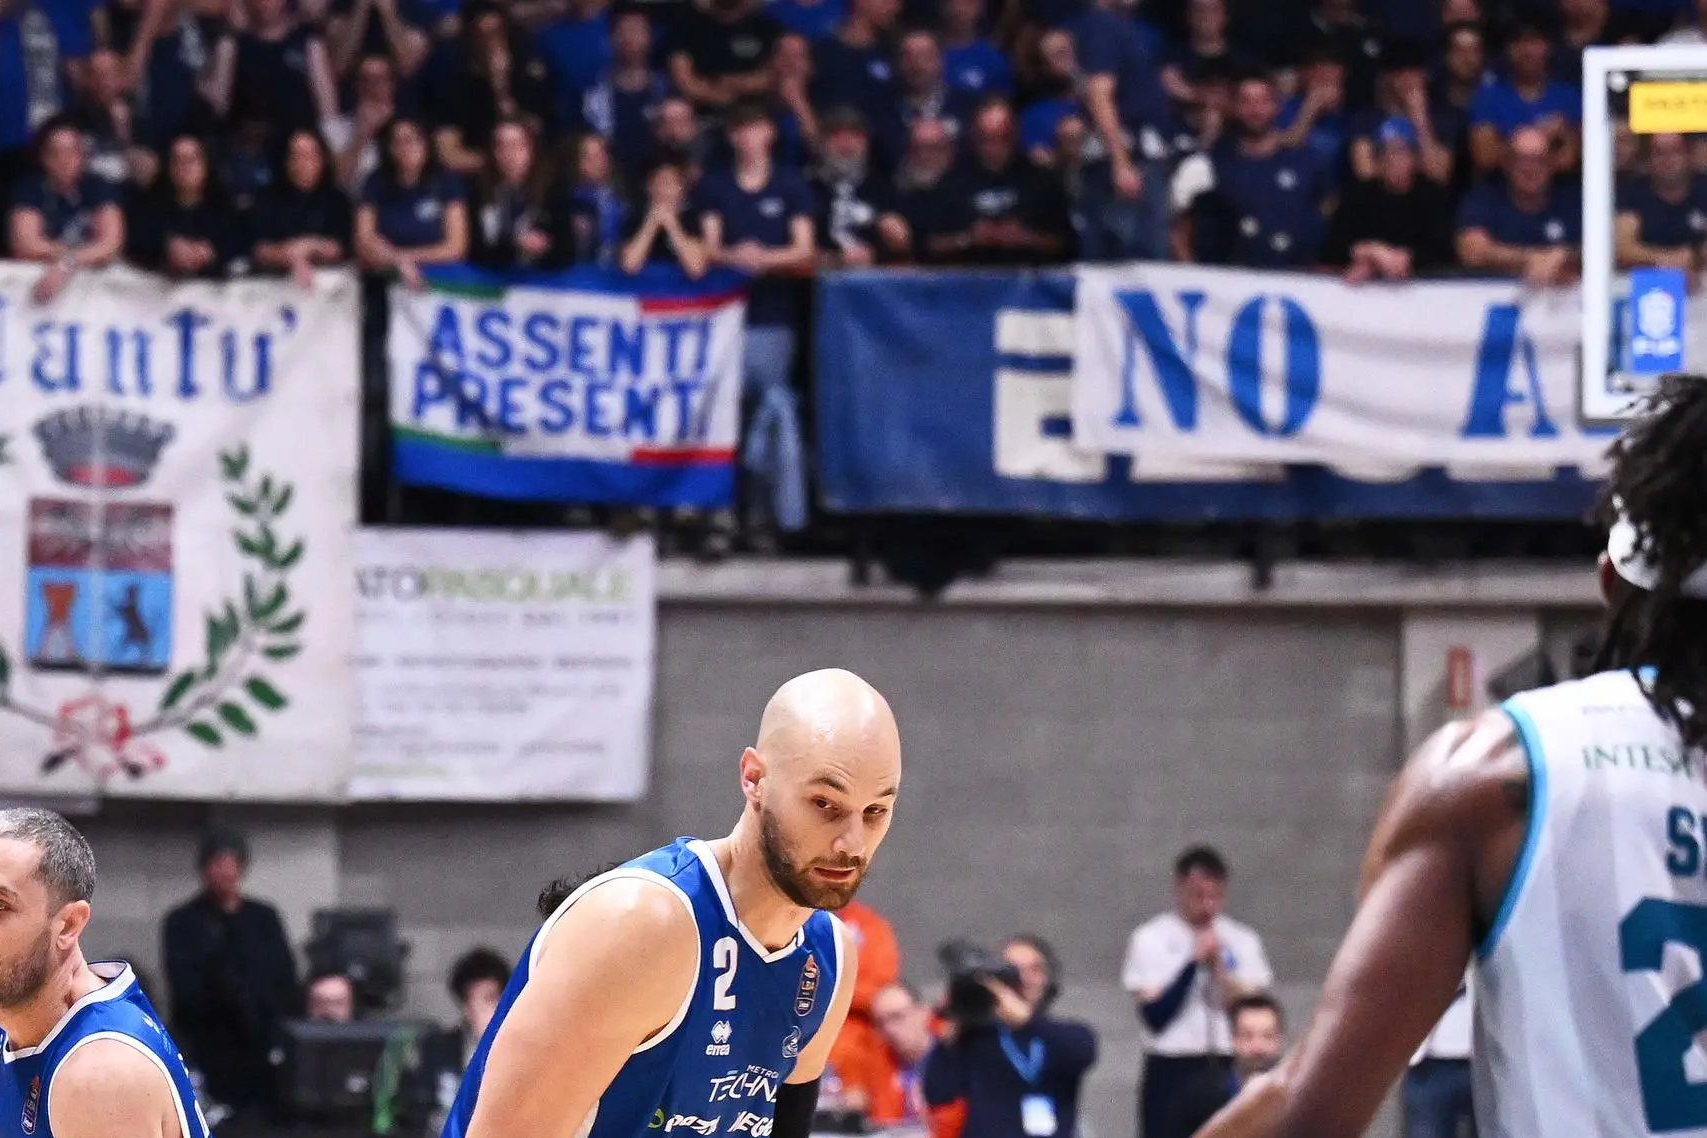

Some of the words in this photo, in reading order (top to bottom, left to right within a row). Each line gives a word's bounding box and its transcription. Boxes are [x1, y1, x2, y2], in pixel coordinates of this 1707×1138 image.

[427, 305, 710, 378] ASSENTI
[1115, 287, 1321, 437] NO
[1664, 804, 1707, 880] S
[713, 936, 739, 1011] 2
